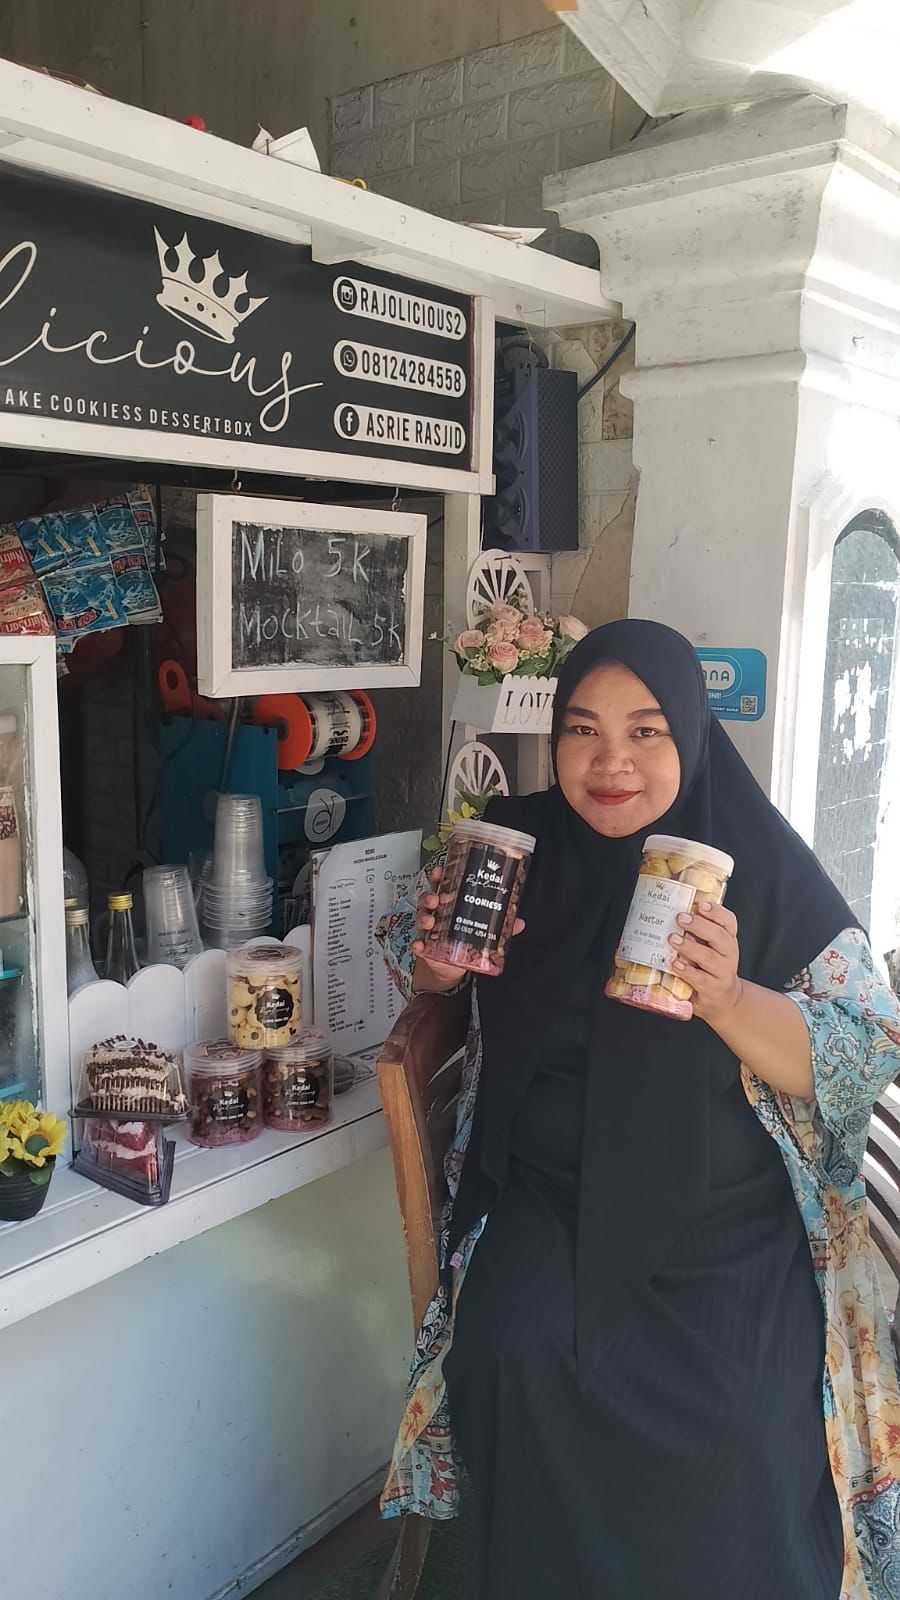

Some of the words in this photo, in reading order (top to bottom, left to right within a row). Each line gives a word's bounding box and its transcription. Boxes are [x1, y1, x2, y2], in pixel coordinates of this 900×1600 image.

[361, 287, 462, 335] RAJOLICIOUS2
[362, 350, 462, 393] 08124284558
[51, 395, 142, 422] COOKIESS
[150, 409, 253, 436] DESSERTBOX
[366, 412, 410, 442] ASRIE
[415, 420, 462, 450] RASJID
[504, 690, 555, 726] LOV
[477, 868, 504, 884] Kedai
[647, 889, 671, 903] Kedai
